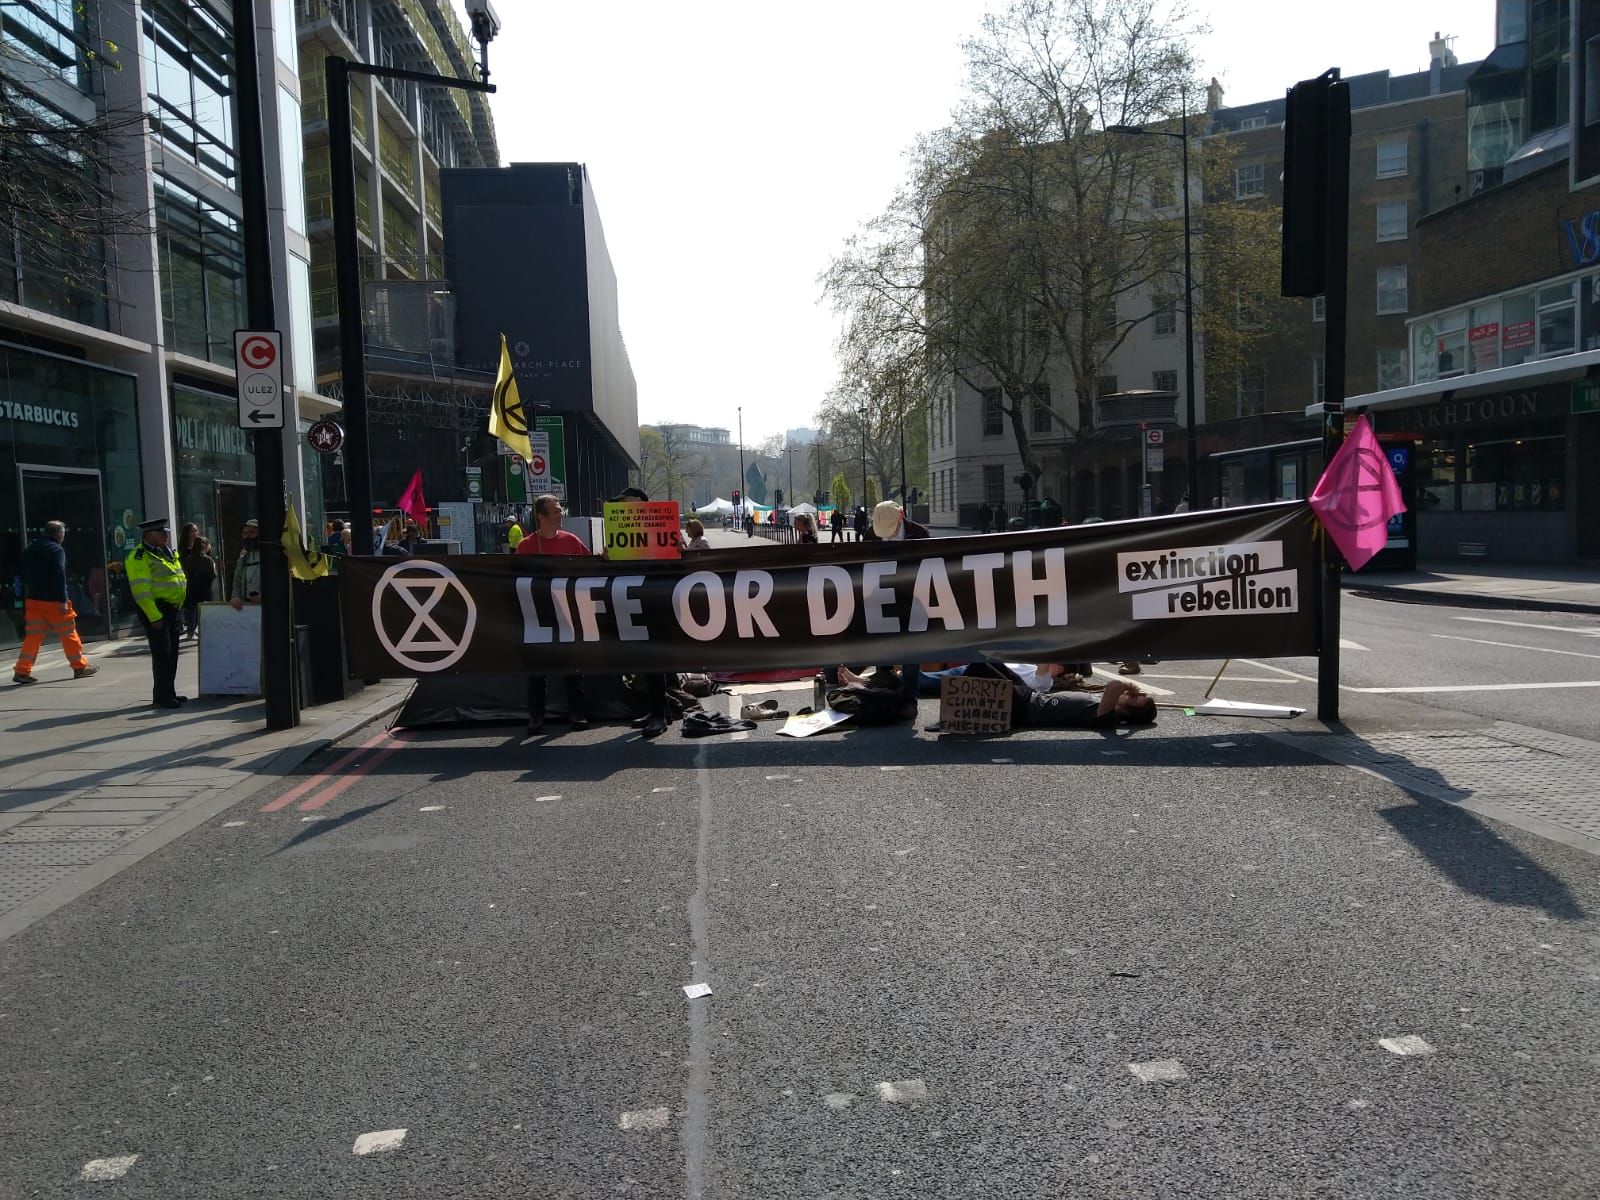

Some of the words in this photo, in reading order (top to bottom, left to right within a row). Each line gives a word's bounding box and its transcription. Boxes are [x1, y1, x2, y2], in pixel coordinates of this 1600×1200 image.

[549, 360, 581, 368] PLACE
[248, 386, 273, 394] ULEZ
[608, 532, 648, 548] JOIN
[657, 532, 679, 547] US
[1125, 547, 1260, 582] extinction
[515, 575, 650, 643] LIFE
[672, 570, 780, 641] OR
[806, 547, 1068, 636] DEATH
[1168, 577, 1292, 613] rebellion
[948, 678, 1007, 697] SORRY!
[947, 697, 1006, 709] CLIMATE
[955, 709, 1008, 720] CHANGE
